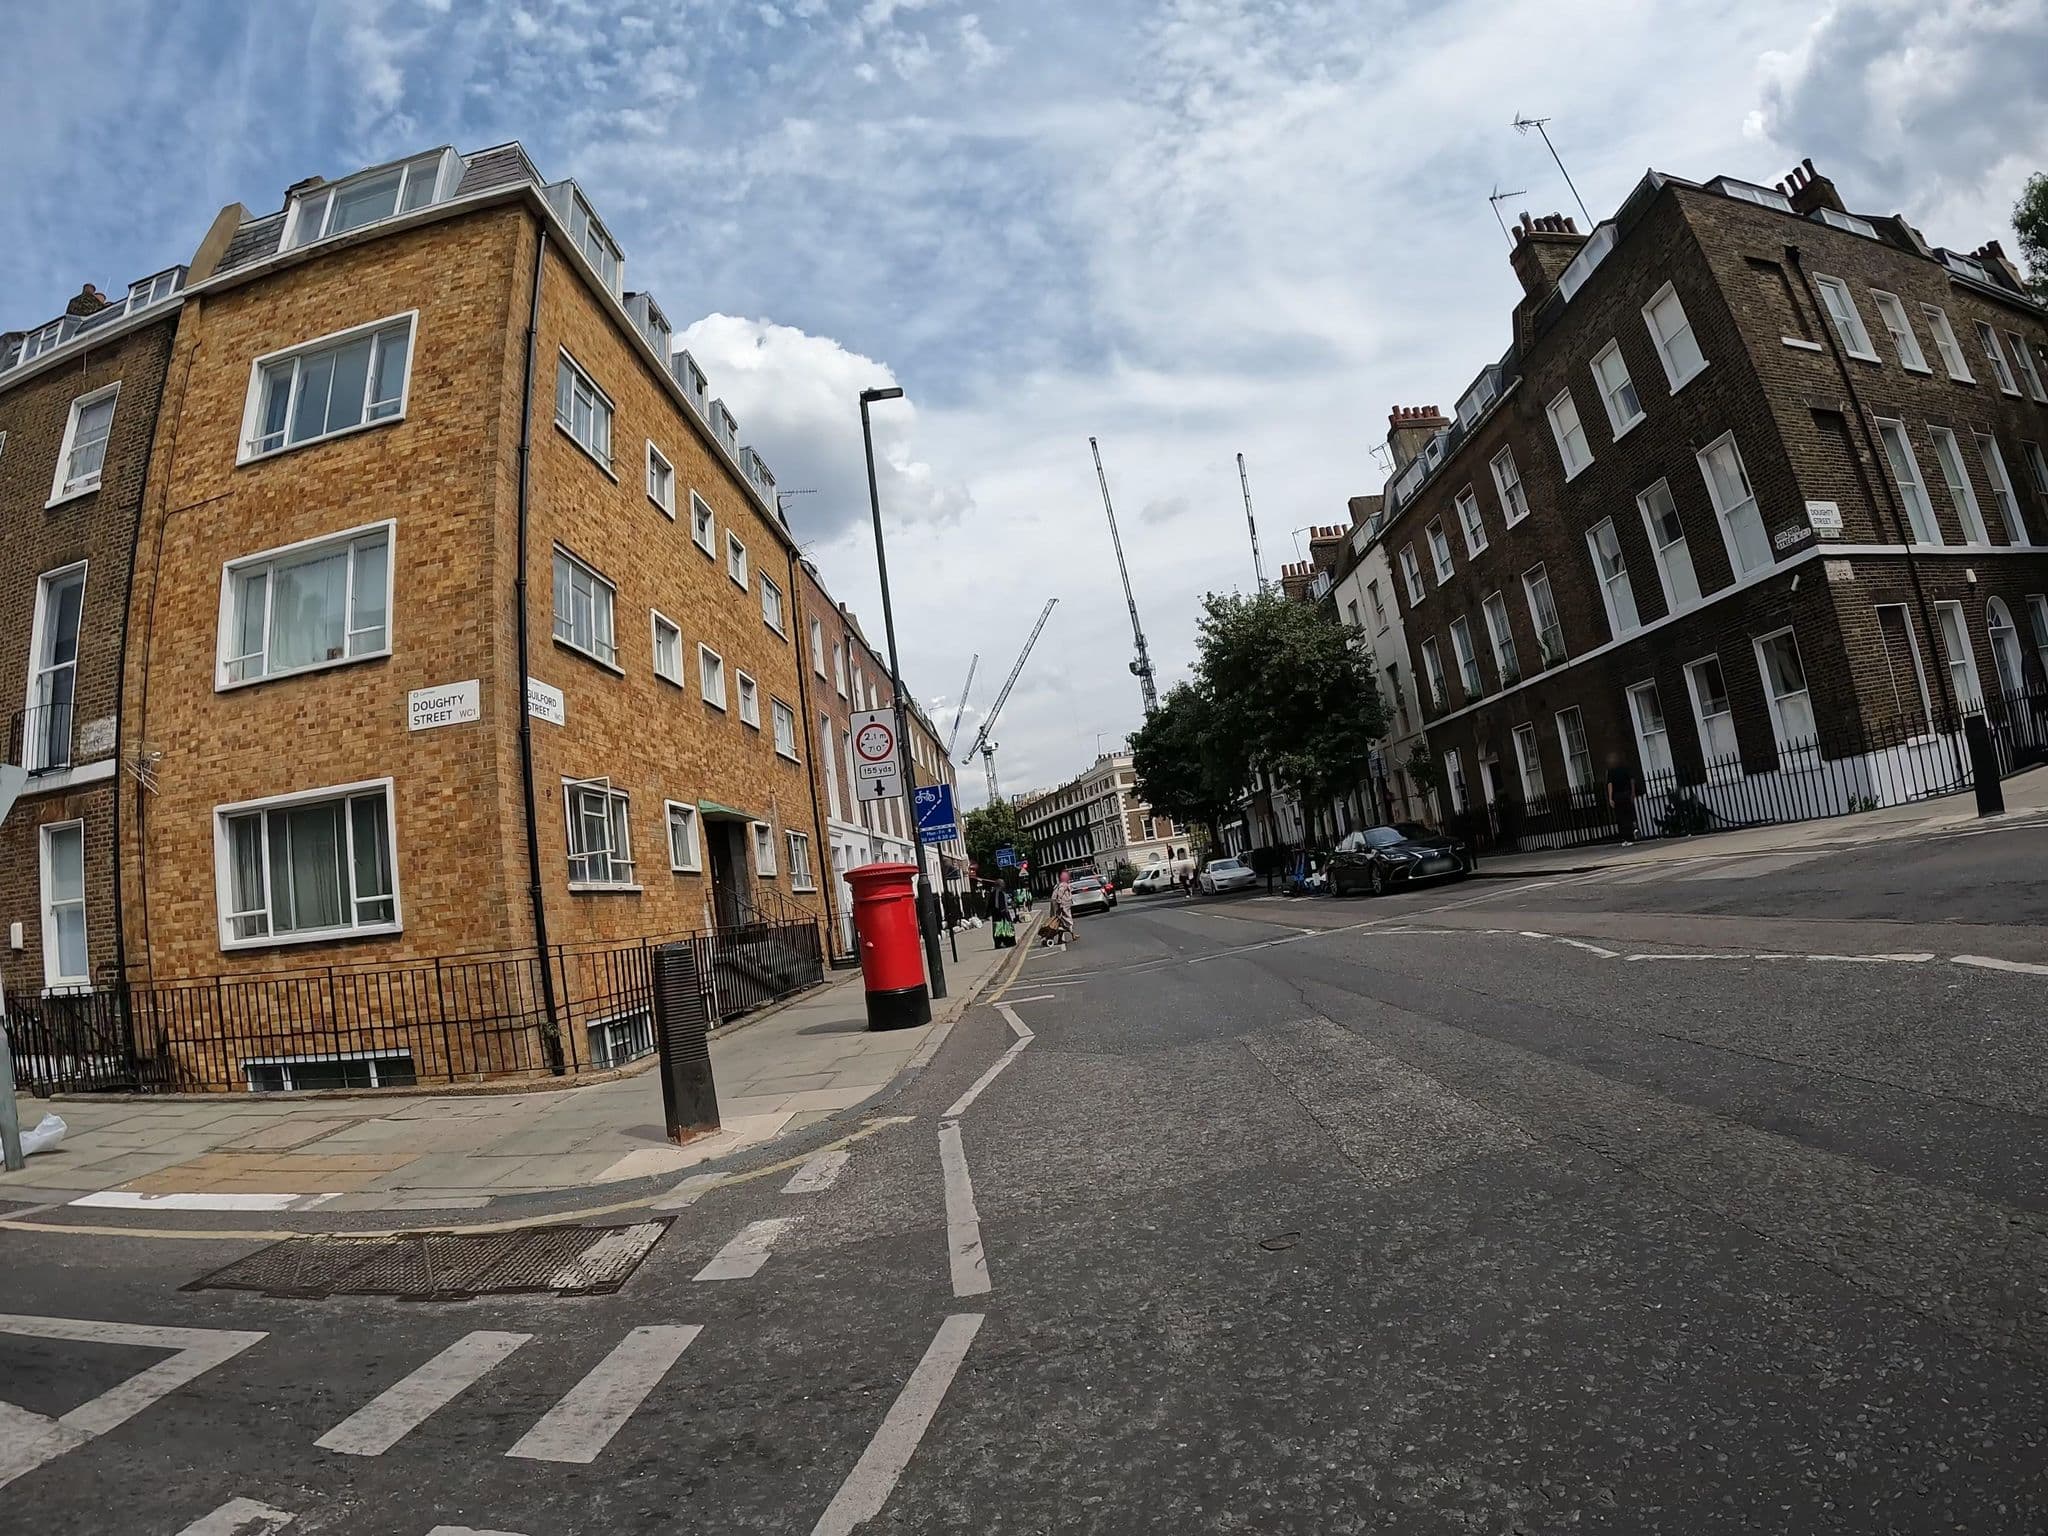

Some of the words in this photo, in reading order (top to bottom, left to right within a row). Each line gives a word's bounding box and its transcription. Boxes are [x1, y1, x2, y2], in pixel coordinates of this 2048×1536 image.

[1813, 517, 1831, 525] STREET
[1775, 526, 1799, 541] GUILFORD
[413, 694, 464, 712] DOUGHTY
[528, 689, 557, 708] GUILFORD
[413, 710, 452, 726] STREET
[459, 708, 476, 718] WC1
[528, 702, 550, 717] STREET
[864, 767, 877, 775] 155
[879, 766, 892, 775] yds
